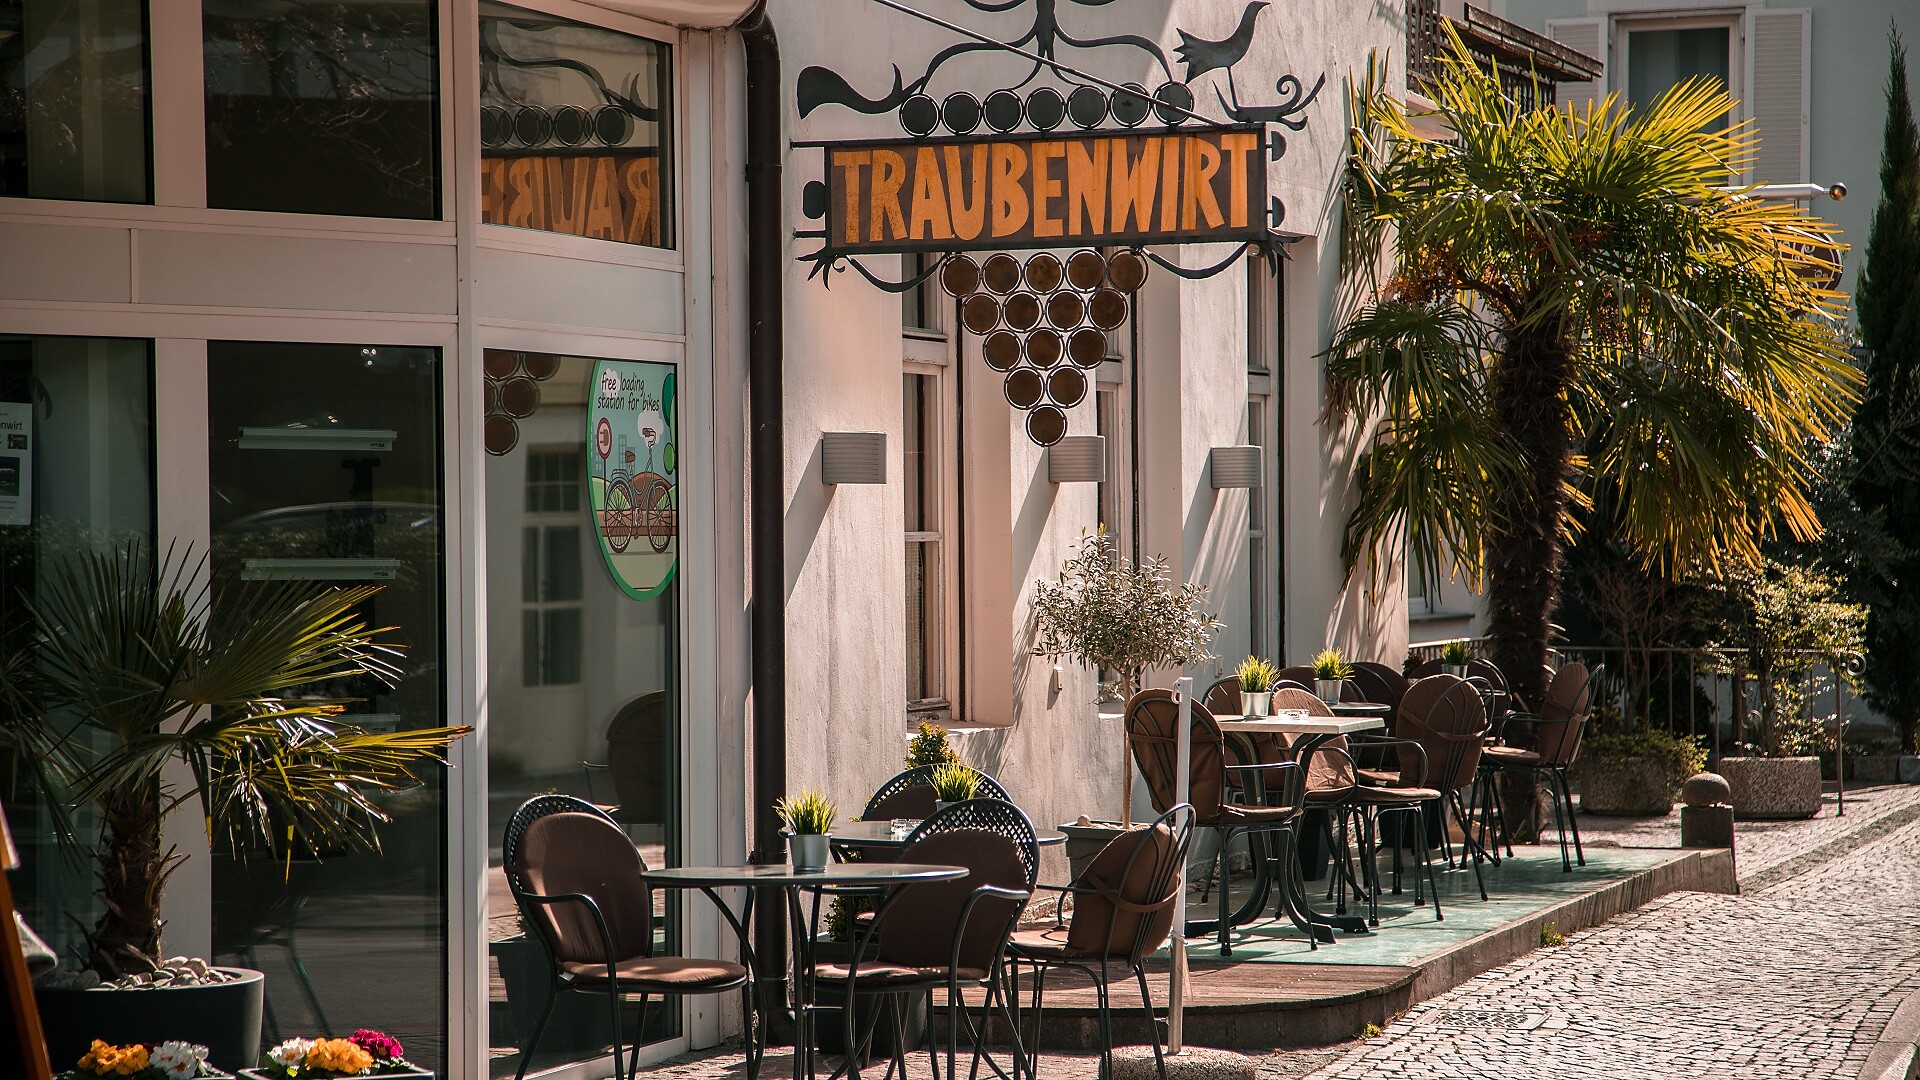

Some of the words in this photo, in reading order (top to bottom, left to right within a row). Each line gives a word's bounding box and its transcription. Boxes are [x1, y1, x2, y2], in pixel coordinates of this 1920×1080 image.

[833, 133, 1258, 244] TRAUBENWIRT
[601, 371, 617, 391] free
[619, 371, 645, 397] loading
[597, 392, 625, 410] station
[628, 391, 640, 411] for
[642, 392, 660, 412] bikes
